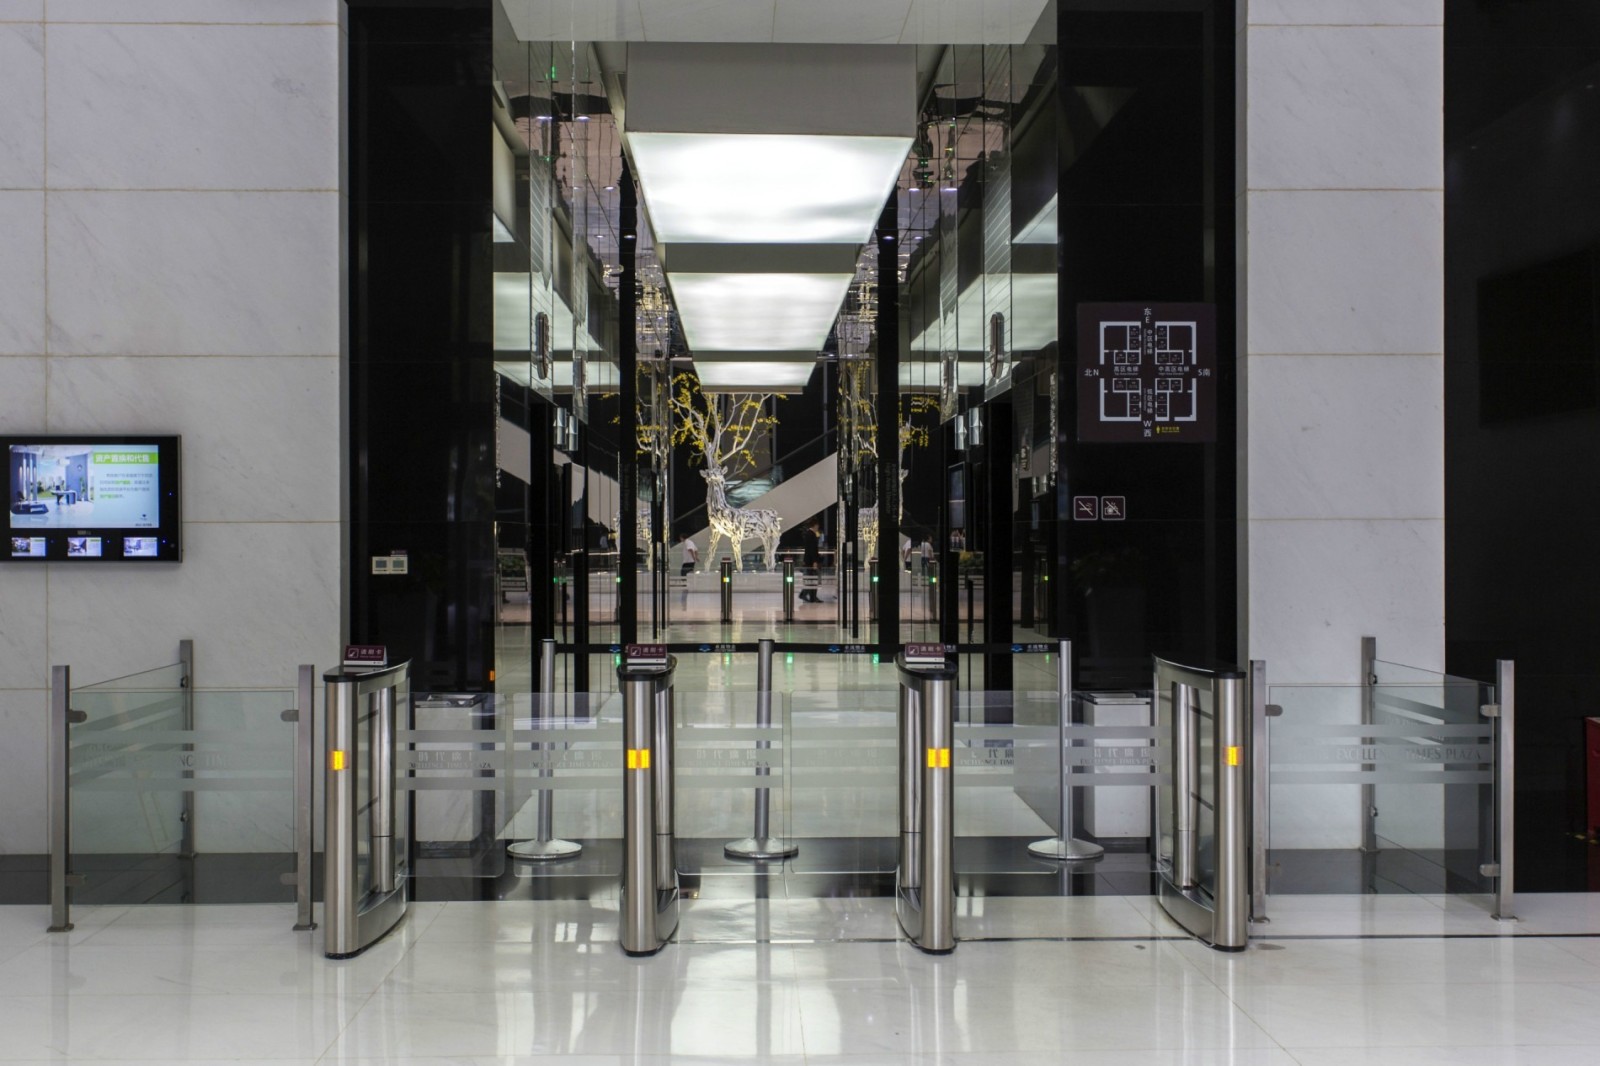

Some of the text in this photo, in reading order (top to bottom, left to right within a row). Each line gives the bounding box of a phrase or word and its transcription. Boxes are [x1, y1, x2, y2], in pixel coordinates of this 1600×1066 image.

[1144, 307, 1152, 316] 东
[1145, 316, 1150, 324] E
[1143, 429, 1152, 438] 西
